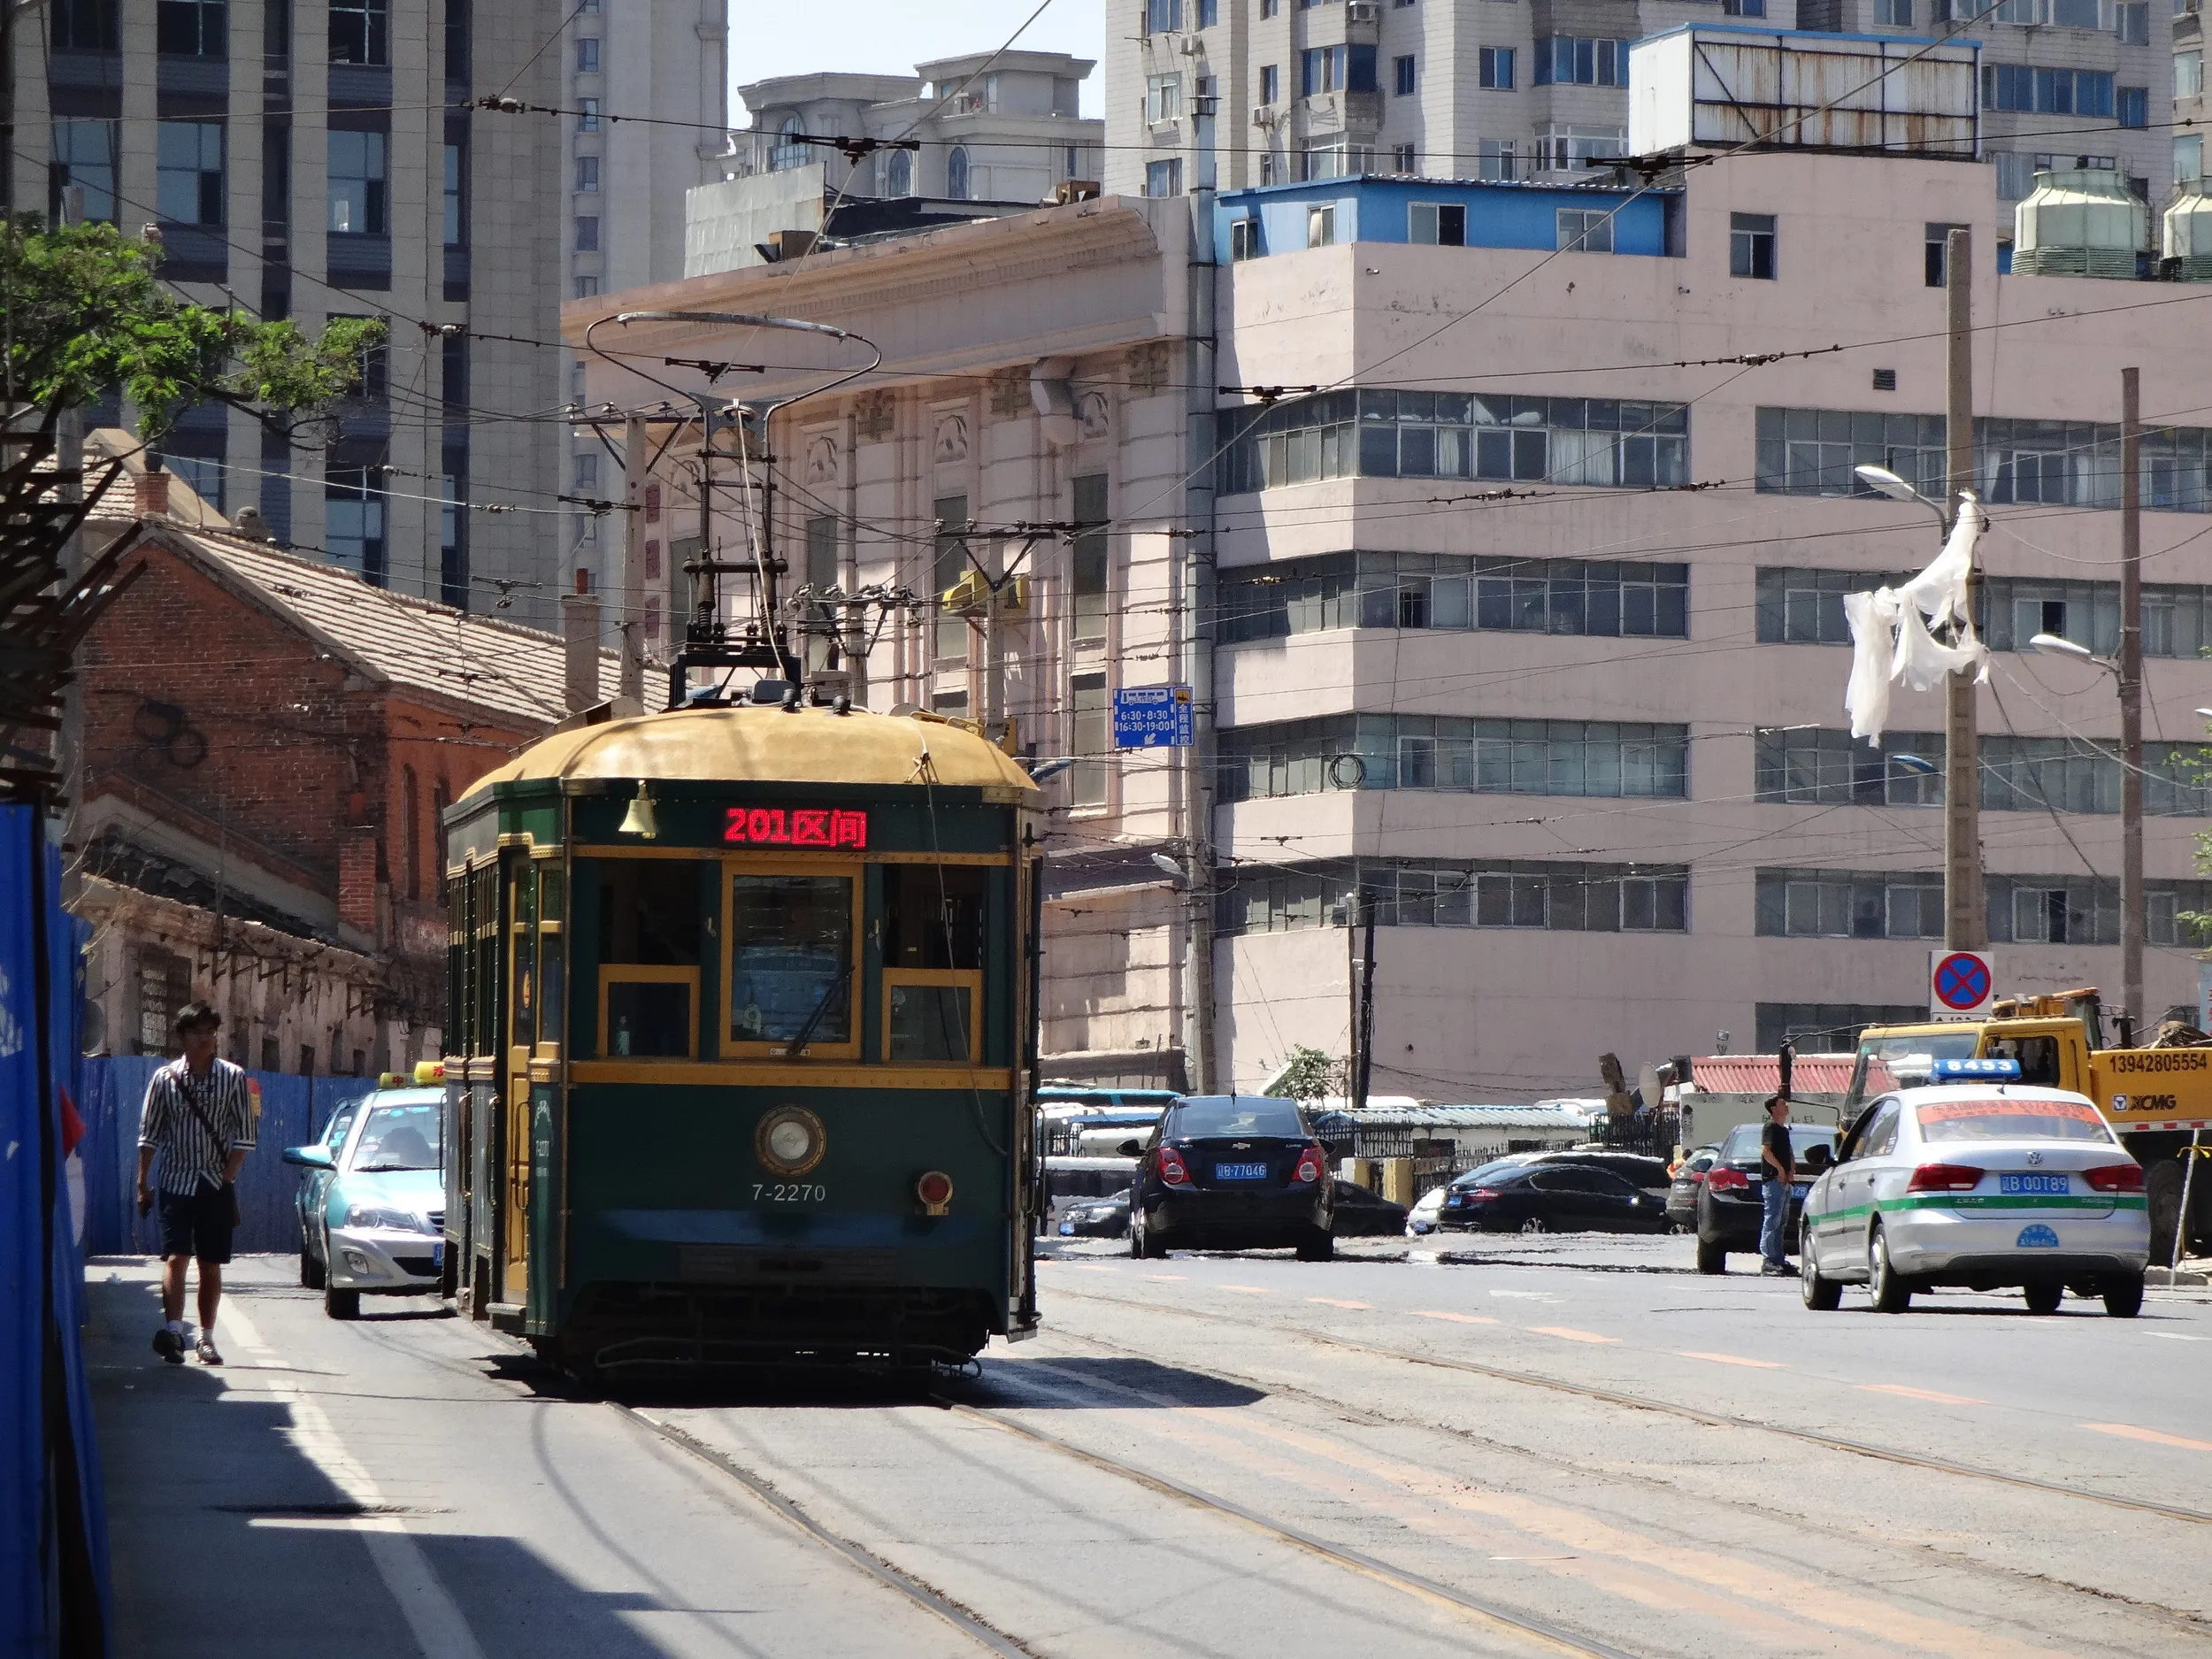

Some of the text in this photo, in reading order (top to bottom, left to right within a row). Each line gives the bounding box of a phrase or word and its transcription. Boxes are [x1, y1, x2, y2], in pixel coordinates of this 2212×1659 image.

[1119, 721, 1170, 732] 16:30-19:00
[1179, 704, 1189, 744] 全程监控
[725, 808, 867, 848] 201区间
[2109, 1053, 2208, 1072] 13942805554
[2130, 1094, 2177, 1110] XCMG
[752, 1184, 826, 1201] 7-2270
